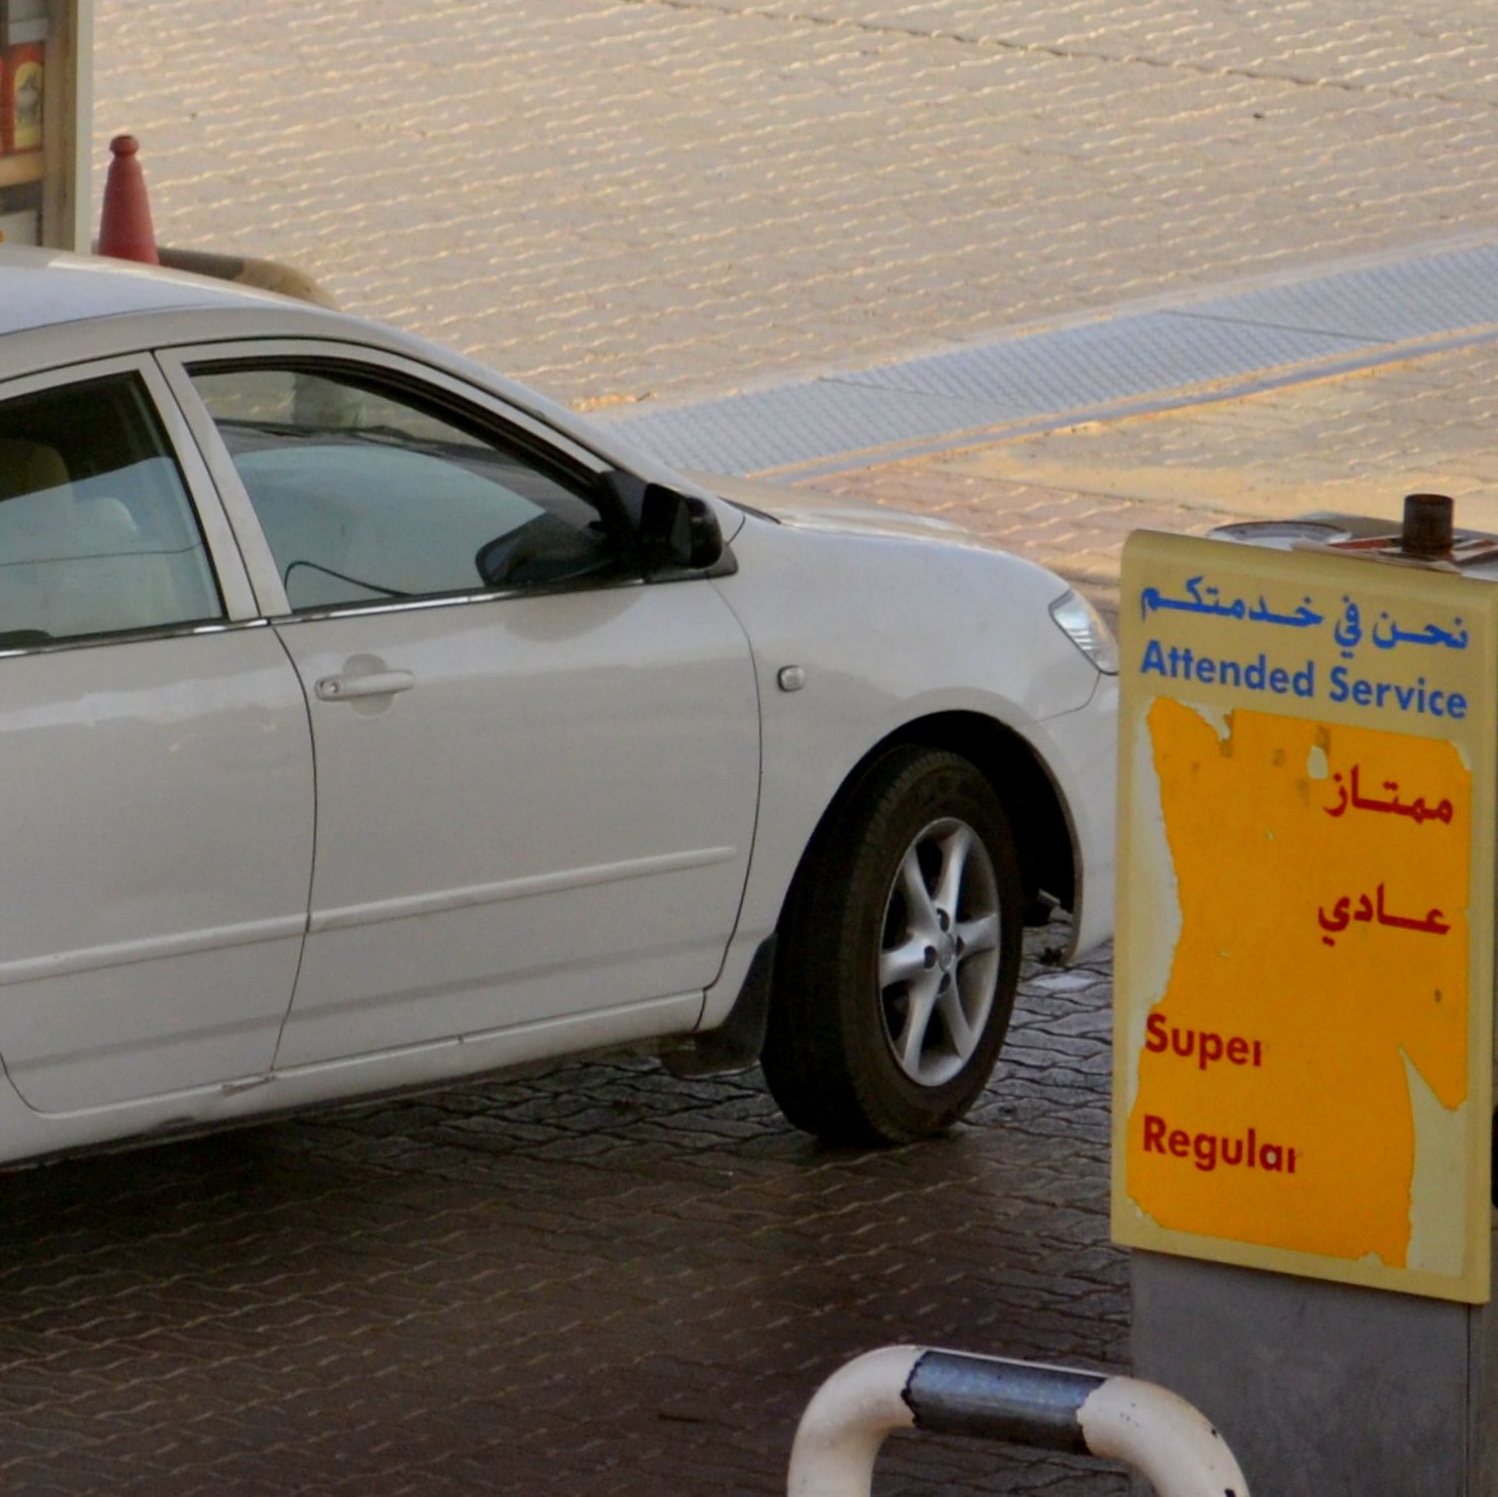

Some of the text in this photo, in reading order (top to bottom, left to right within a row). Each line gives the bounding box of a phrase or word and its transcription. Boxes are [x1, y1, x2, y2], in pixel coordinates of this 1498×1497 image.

[1140, 576, 1469, 660] نحن في خدمتكم
[1140, 639, 1468, 719] Attended Service
[1323, 764, 1453, 825] ممتاز
[1317, 881, 1451, 948] عادي
